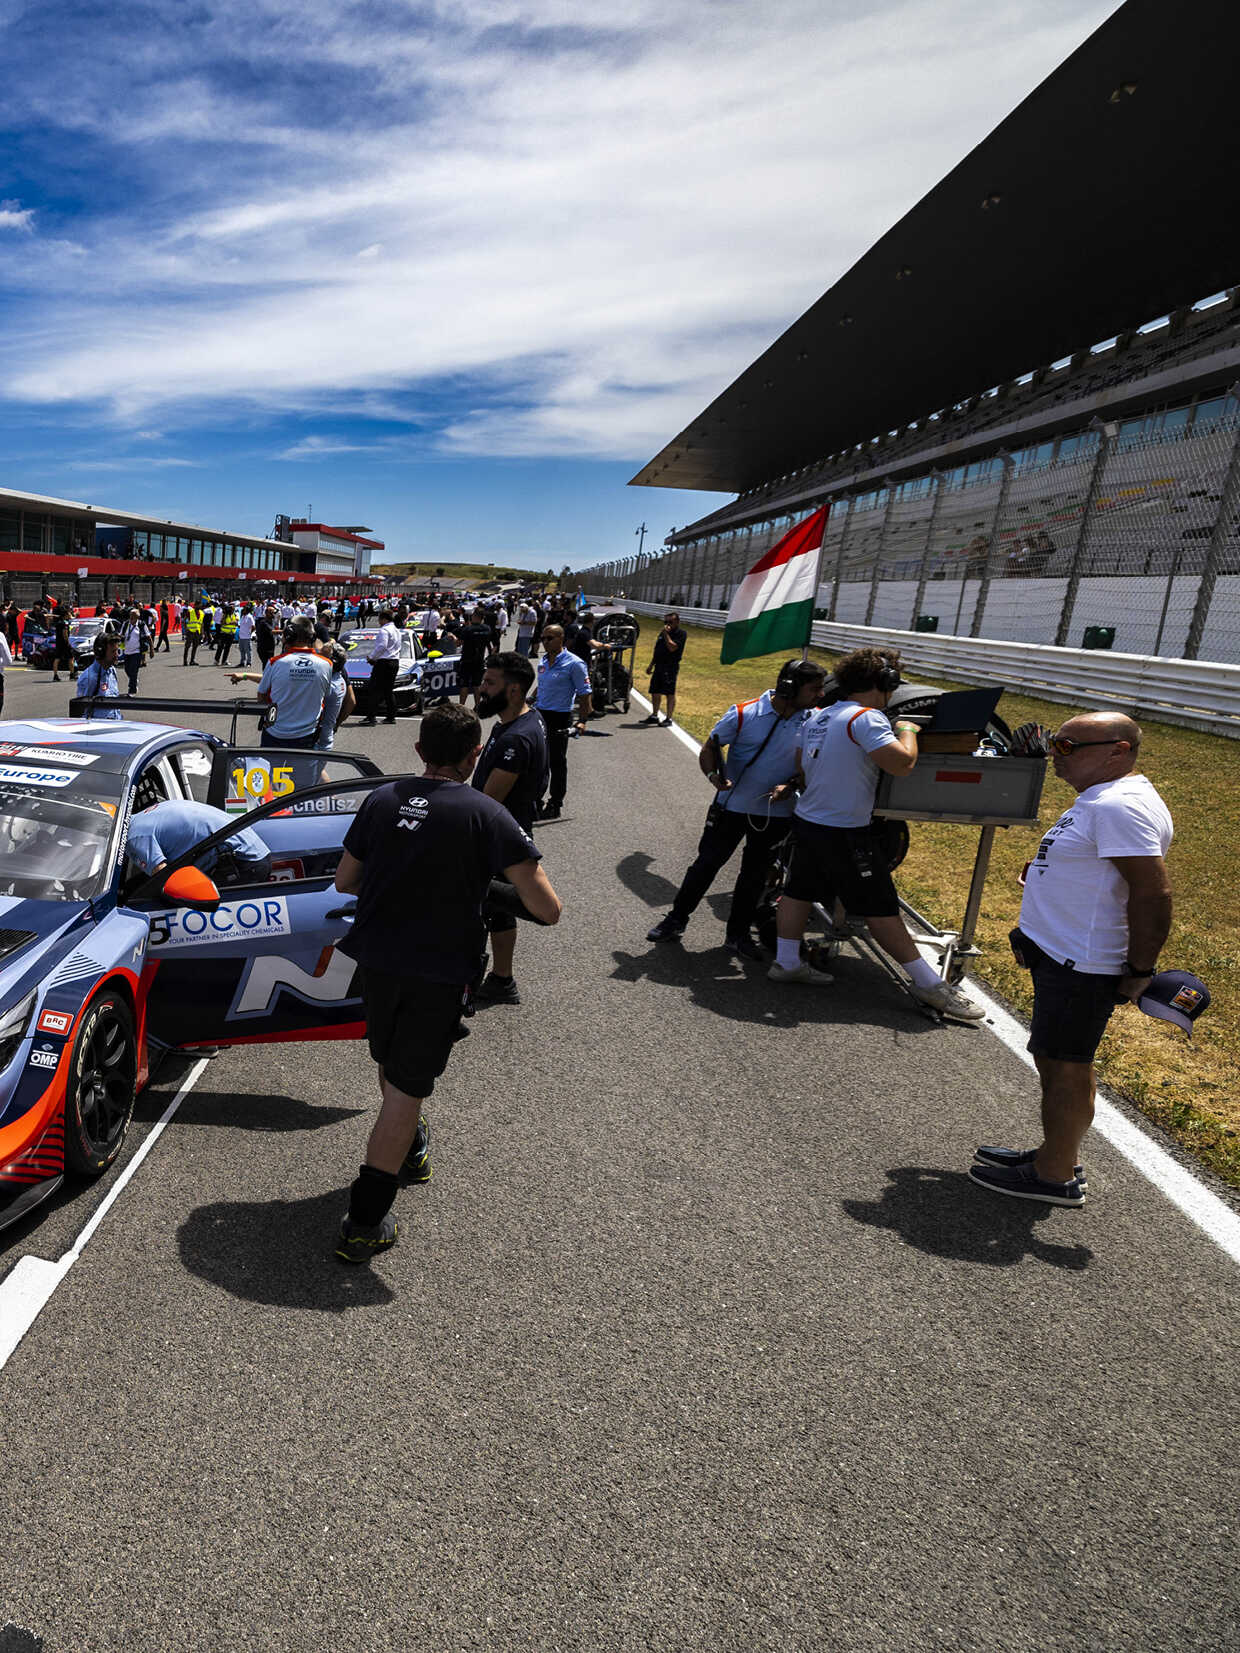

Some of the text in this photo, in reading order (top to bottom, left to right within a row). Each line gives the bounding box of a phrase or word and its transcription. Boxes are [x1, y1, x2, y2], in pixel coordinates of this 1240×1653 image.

[233, 767, 295, 798] 105
[164, 901, 283, 938] FOCOR
[46, 1017, 64, 1026] BRC
[30, 1053, 58, 1066] OMP
